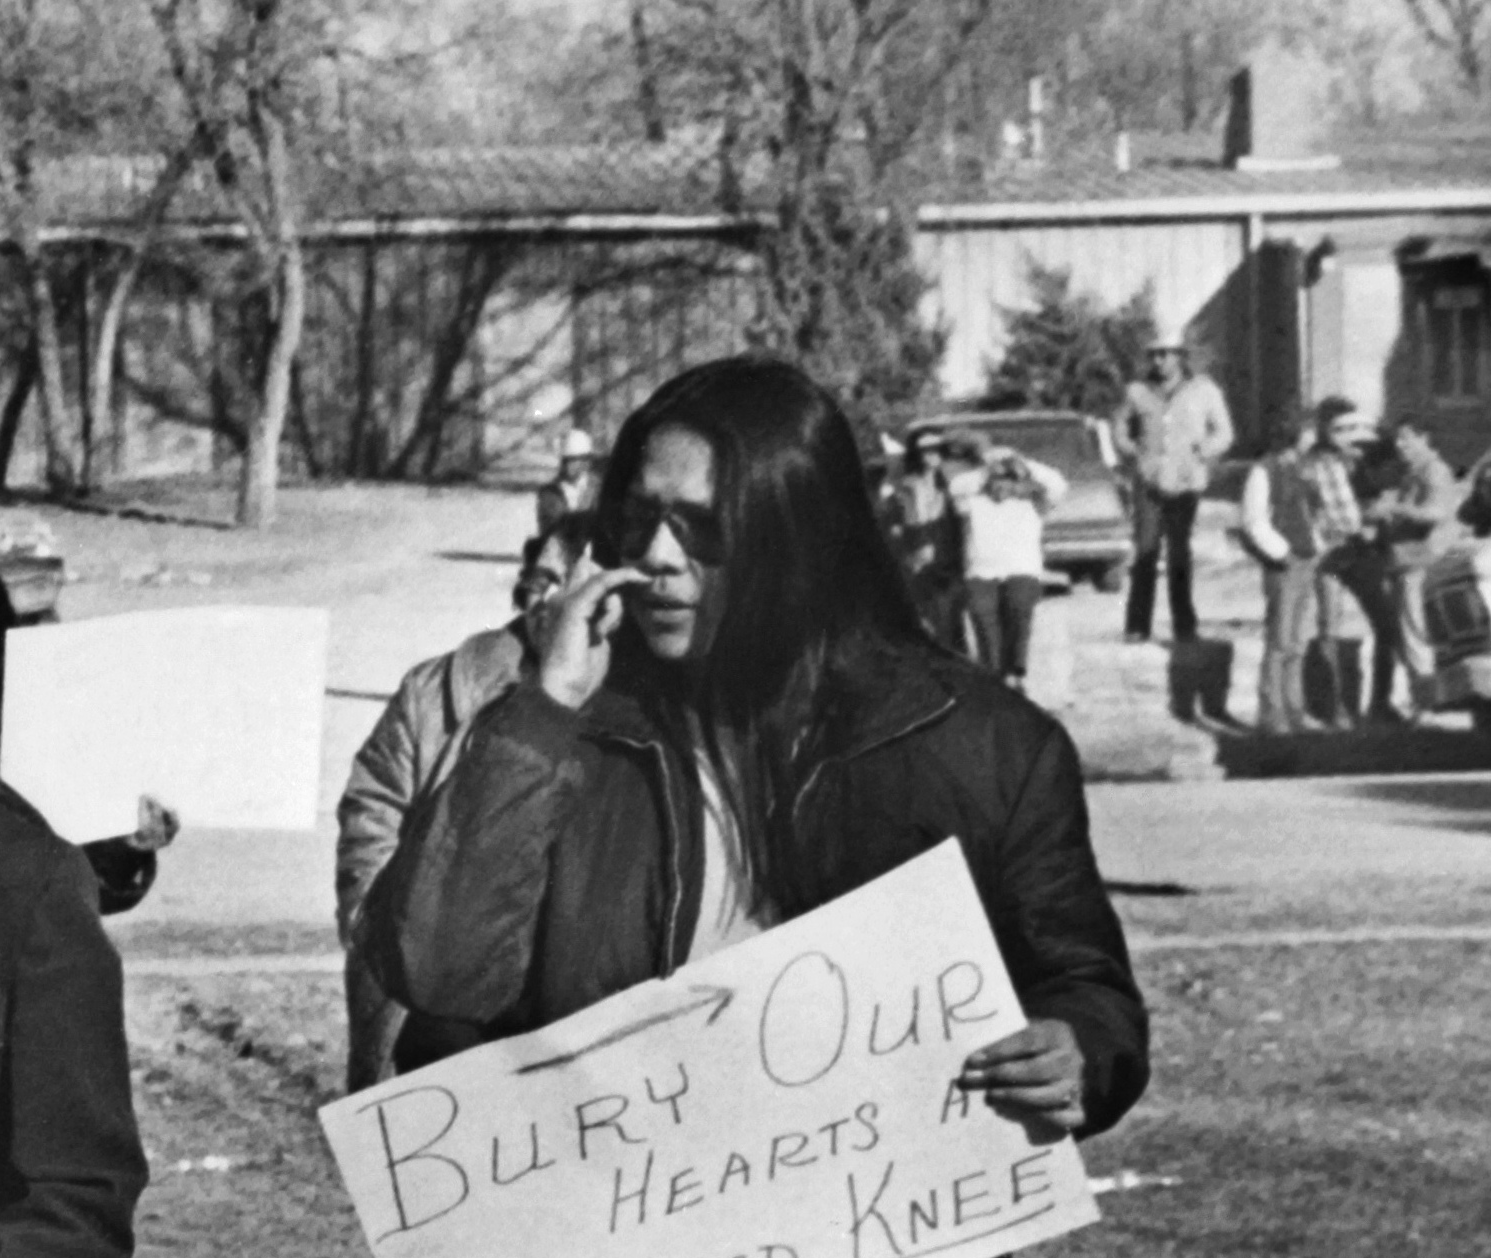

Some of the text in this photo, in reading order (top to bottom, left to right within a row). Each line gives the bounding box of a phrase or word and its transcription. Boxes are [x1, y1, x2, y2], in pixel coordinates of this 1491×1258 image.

[356, 951, 997, 1246] BURY OUR
[607, 1102, 879, 1234] HEARTS
